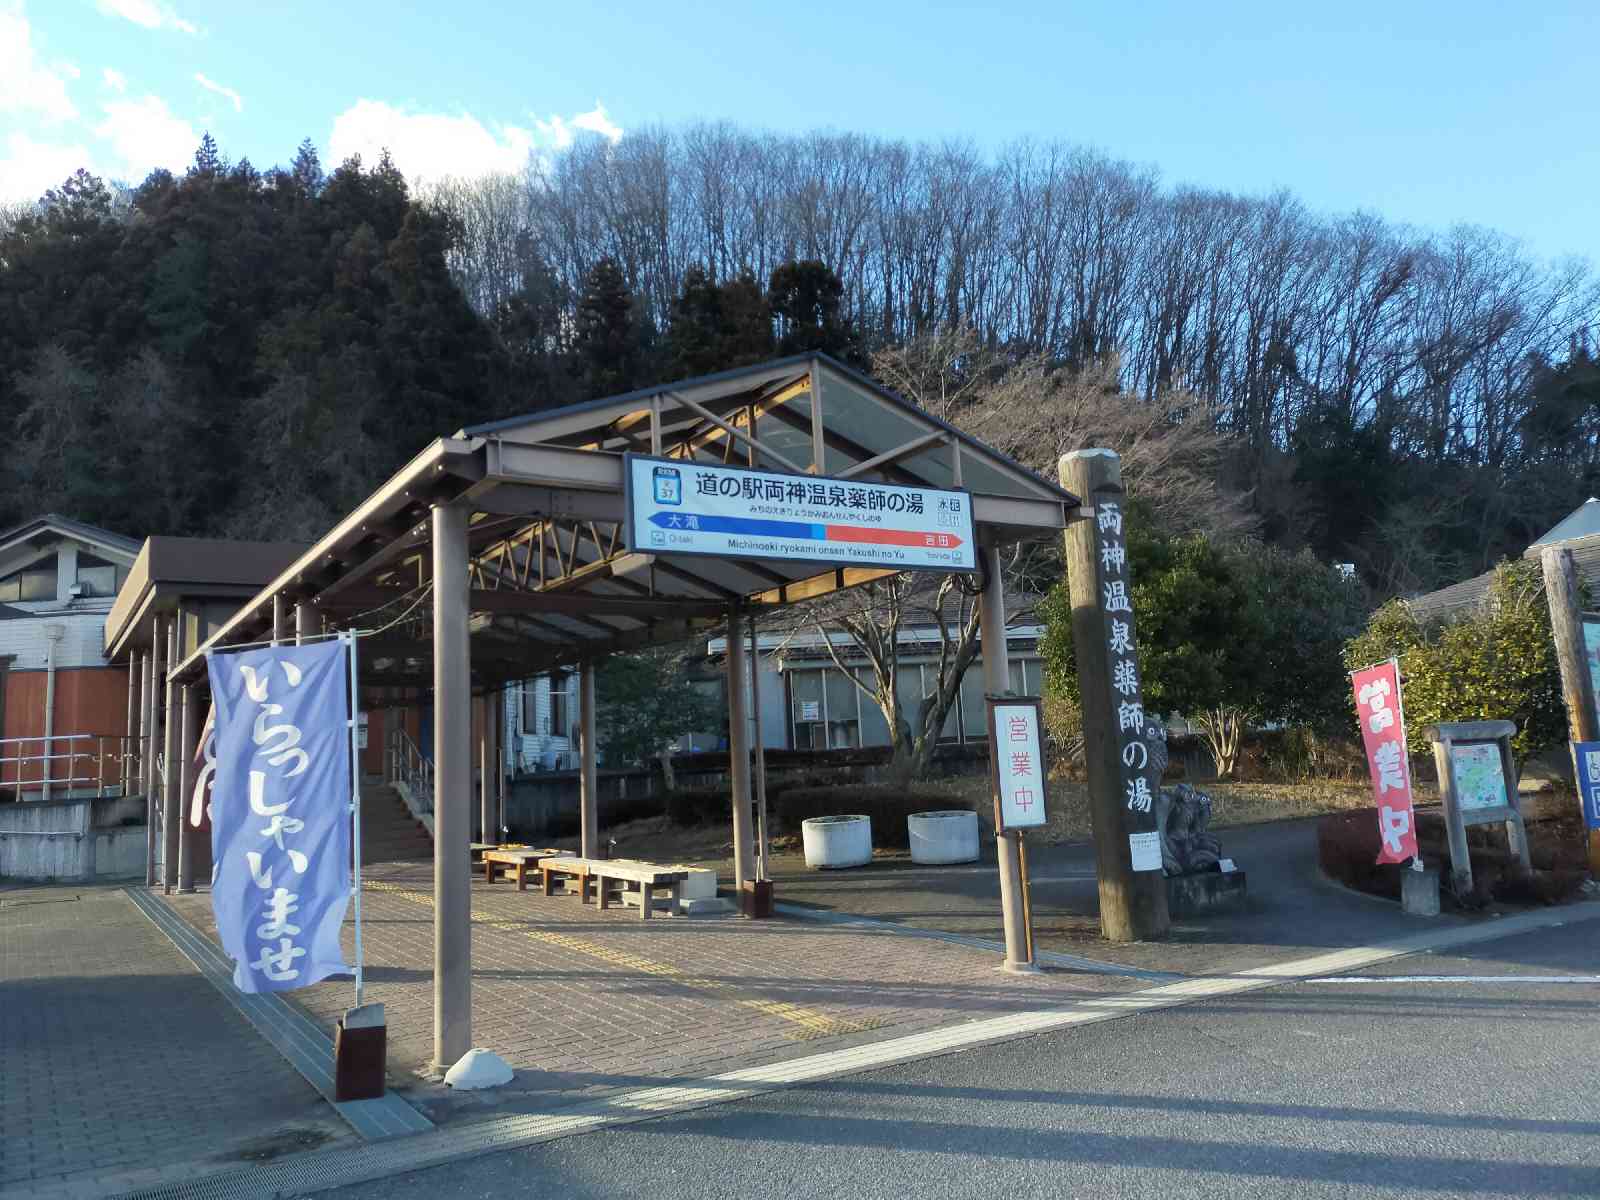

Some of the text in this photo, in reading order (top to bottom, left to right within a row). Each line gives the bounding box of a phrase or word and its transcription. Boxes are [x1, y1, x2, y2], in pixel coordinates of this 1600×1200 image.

[696, 472, 924, 515] 道の駅両神温泉薬師の湯
[1097, 502, 1153, 813] 両神温泉薬師の湯
[240, 660, 310, 982] いらっしゃいませ
[1009, 715, 1033, 813] 営業中
[1358, 677, 1410, 854] 営業中
